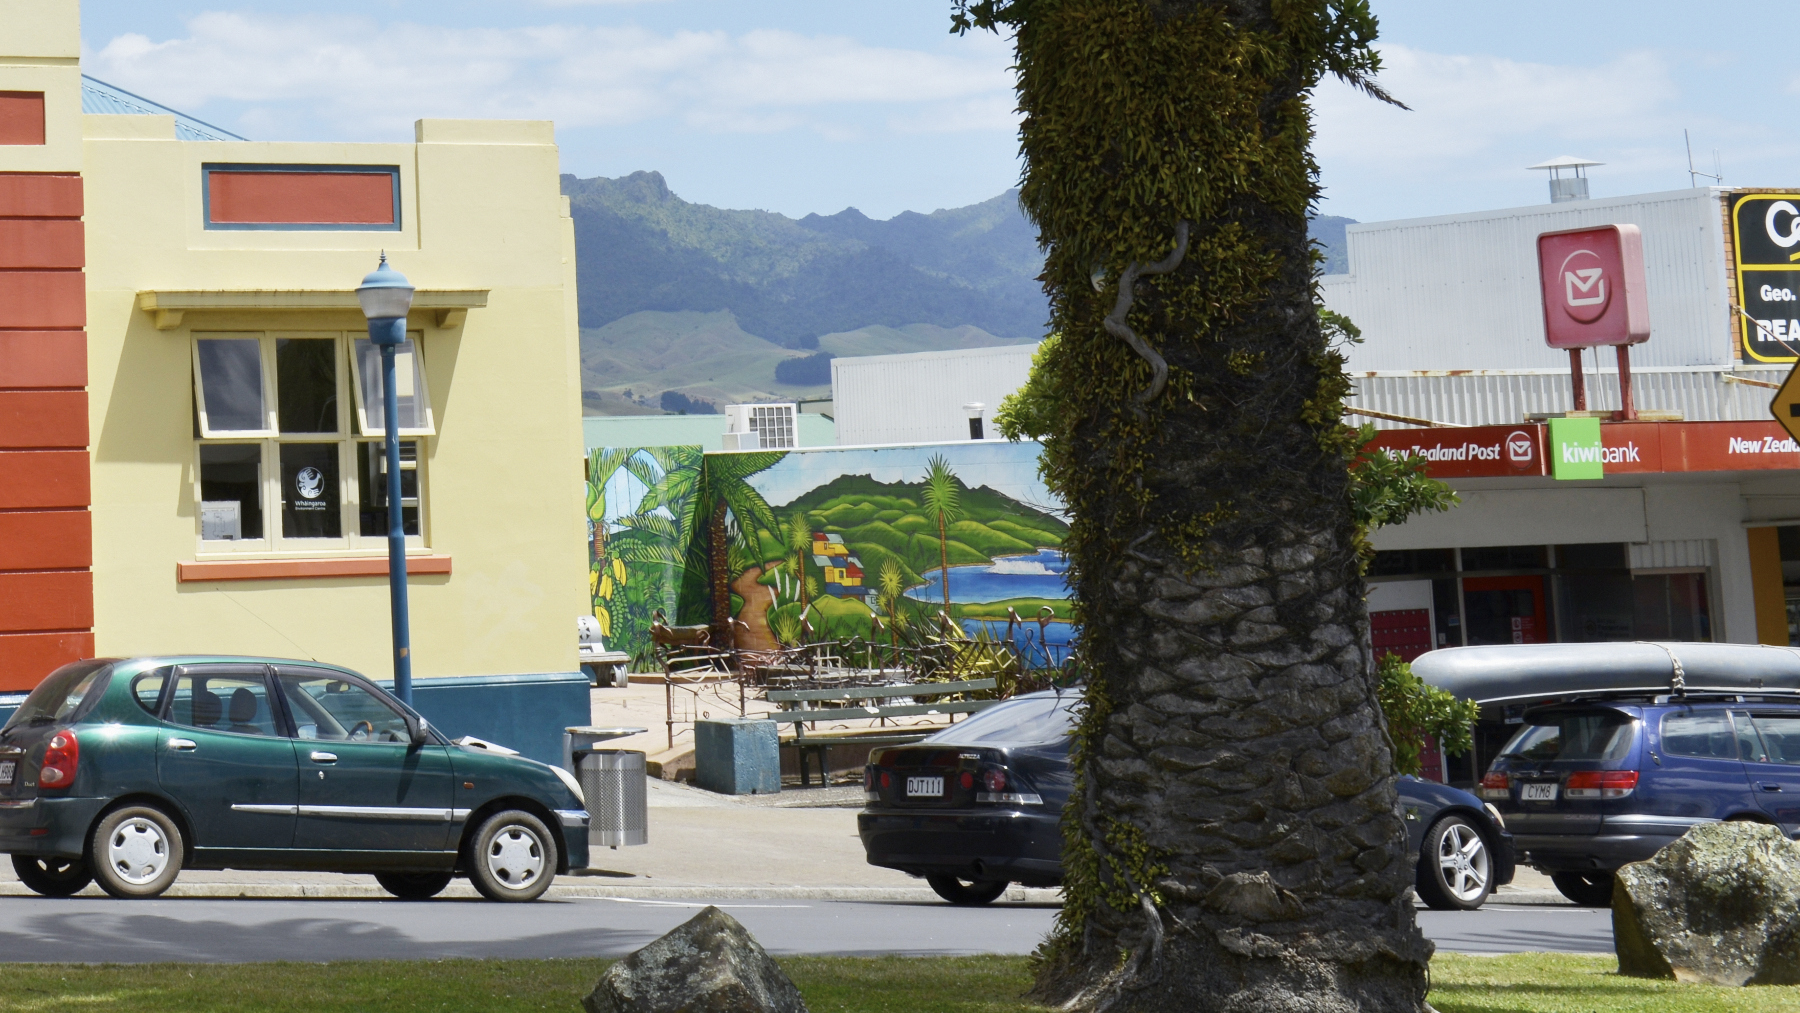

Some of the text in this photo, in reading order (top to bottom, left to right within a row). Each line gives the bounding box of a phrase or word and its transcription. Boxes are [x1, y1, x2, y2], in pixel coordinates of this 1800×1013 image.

[1760, 284, 1797, 302] Geo.
[1468, 443, 1501, 461] Post
[1562, 441, 1640, 464] kiwibank
[1728, 437, 1763, 454] New
[908, 779, 940, 794] DJT111
[1528, 785, 1551, 798] CYM8
